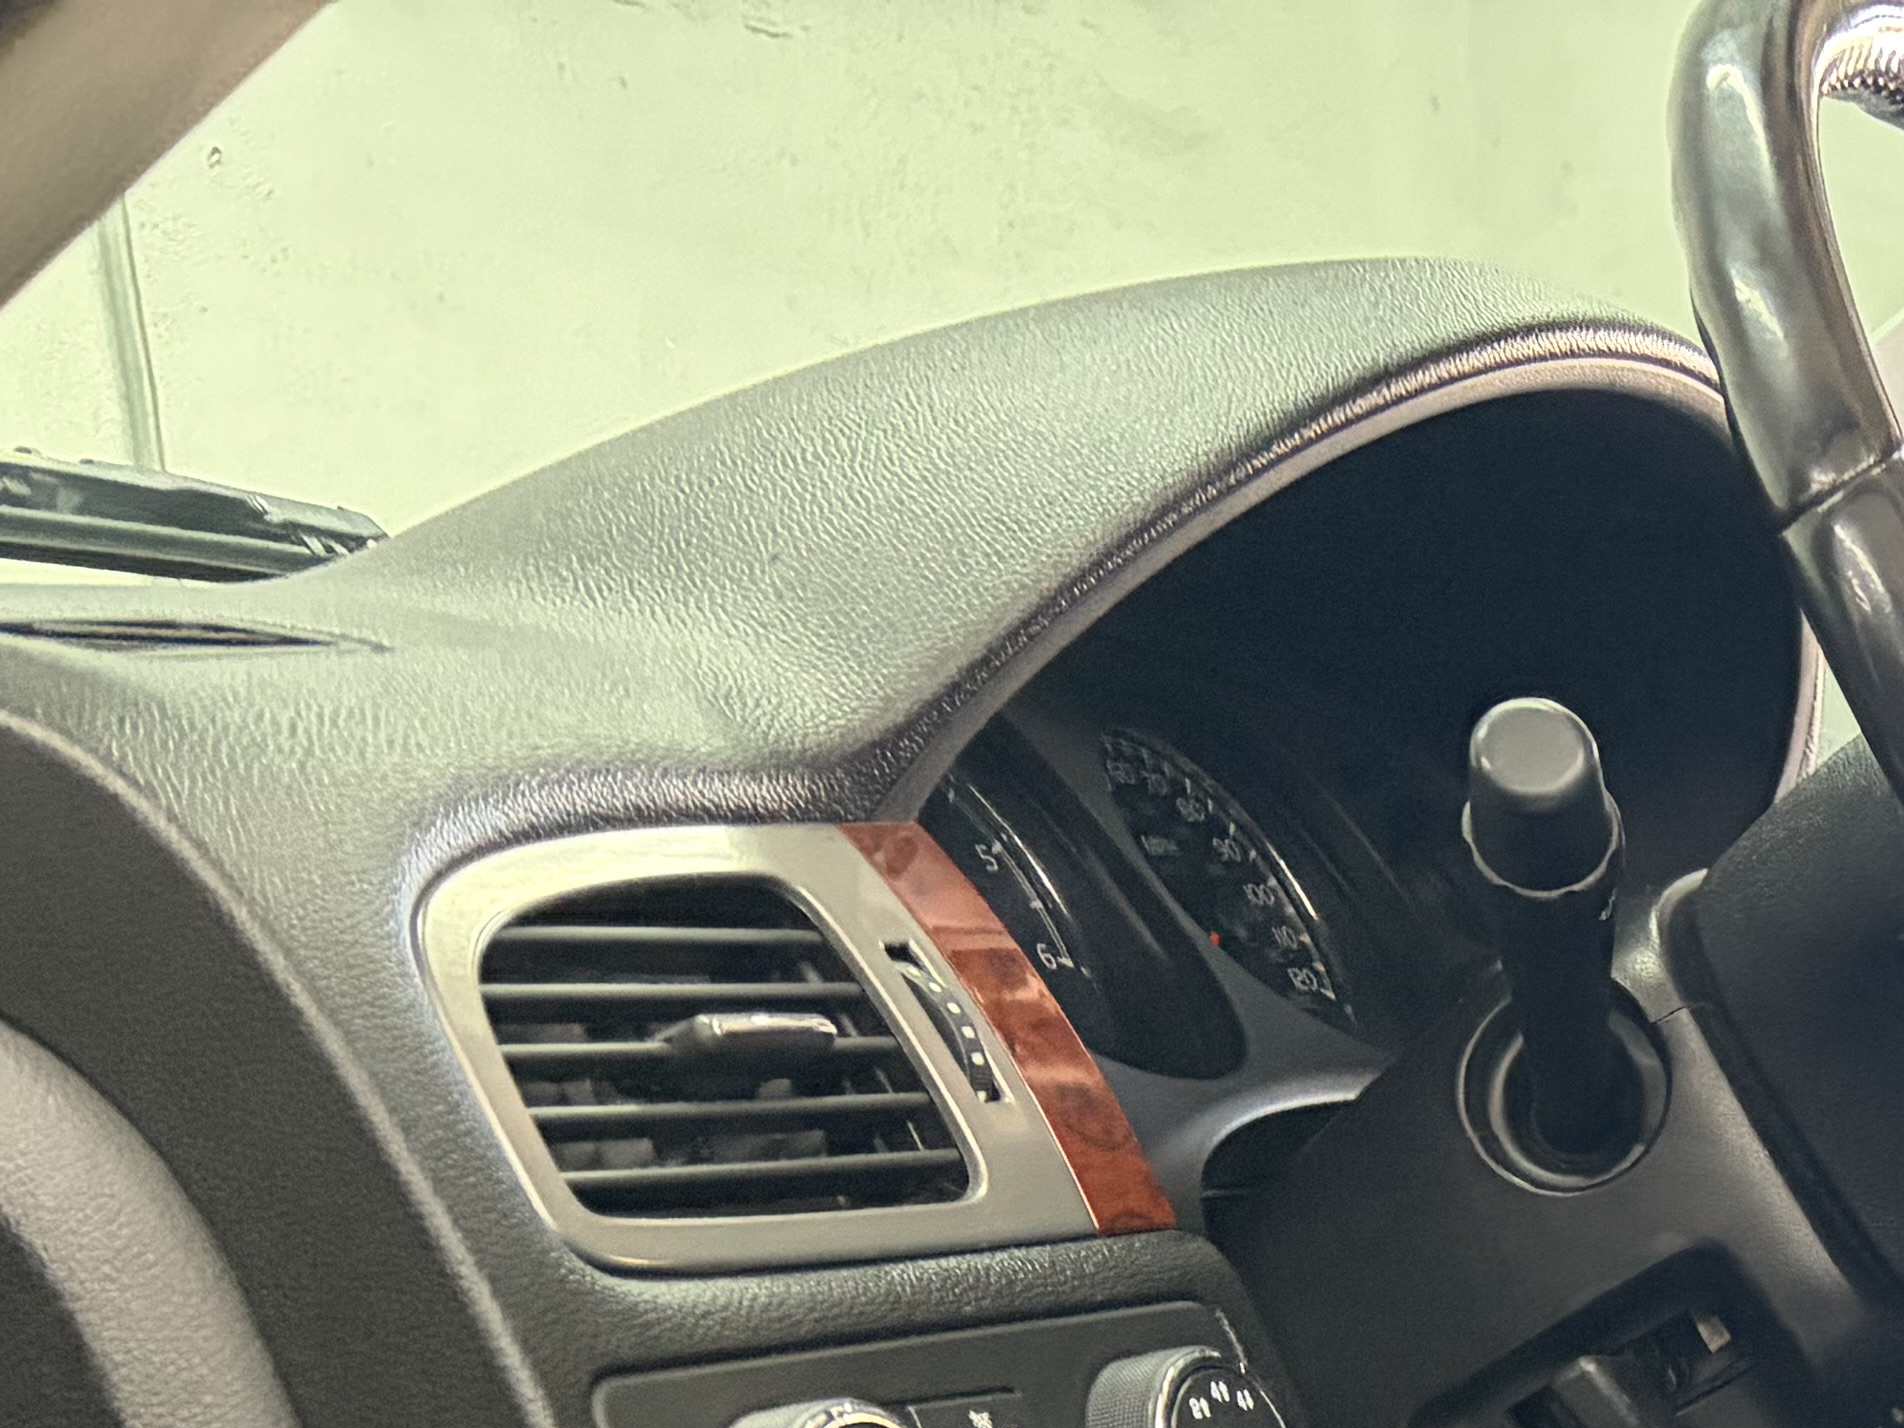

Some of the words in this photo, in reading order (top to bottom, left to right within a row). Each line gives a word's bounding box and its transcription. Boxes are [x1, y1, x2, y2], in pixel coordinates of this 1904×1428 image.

[974, 843, 1000, 873] 5
[1243, 882, 1275, 907] 100
[1271, 925, 1298, 950] 110
[1036, 942, 1058, 971] 6
[1287, 966, 1318, 992] 120
